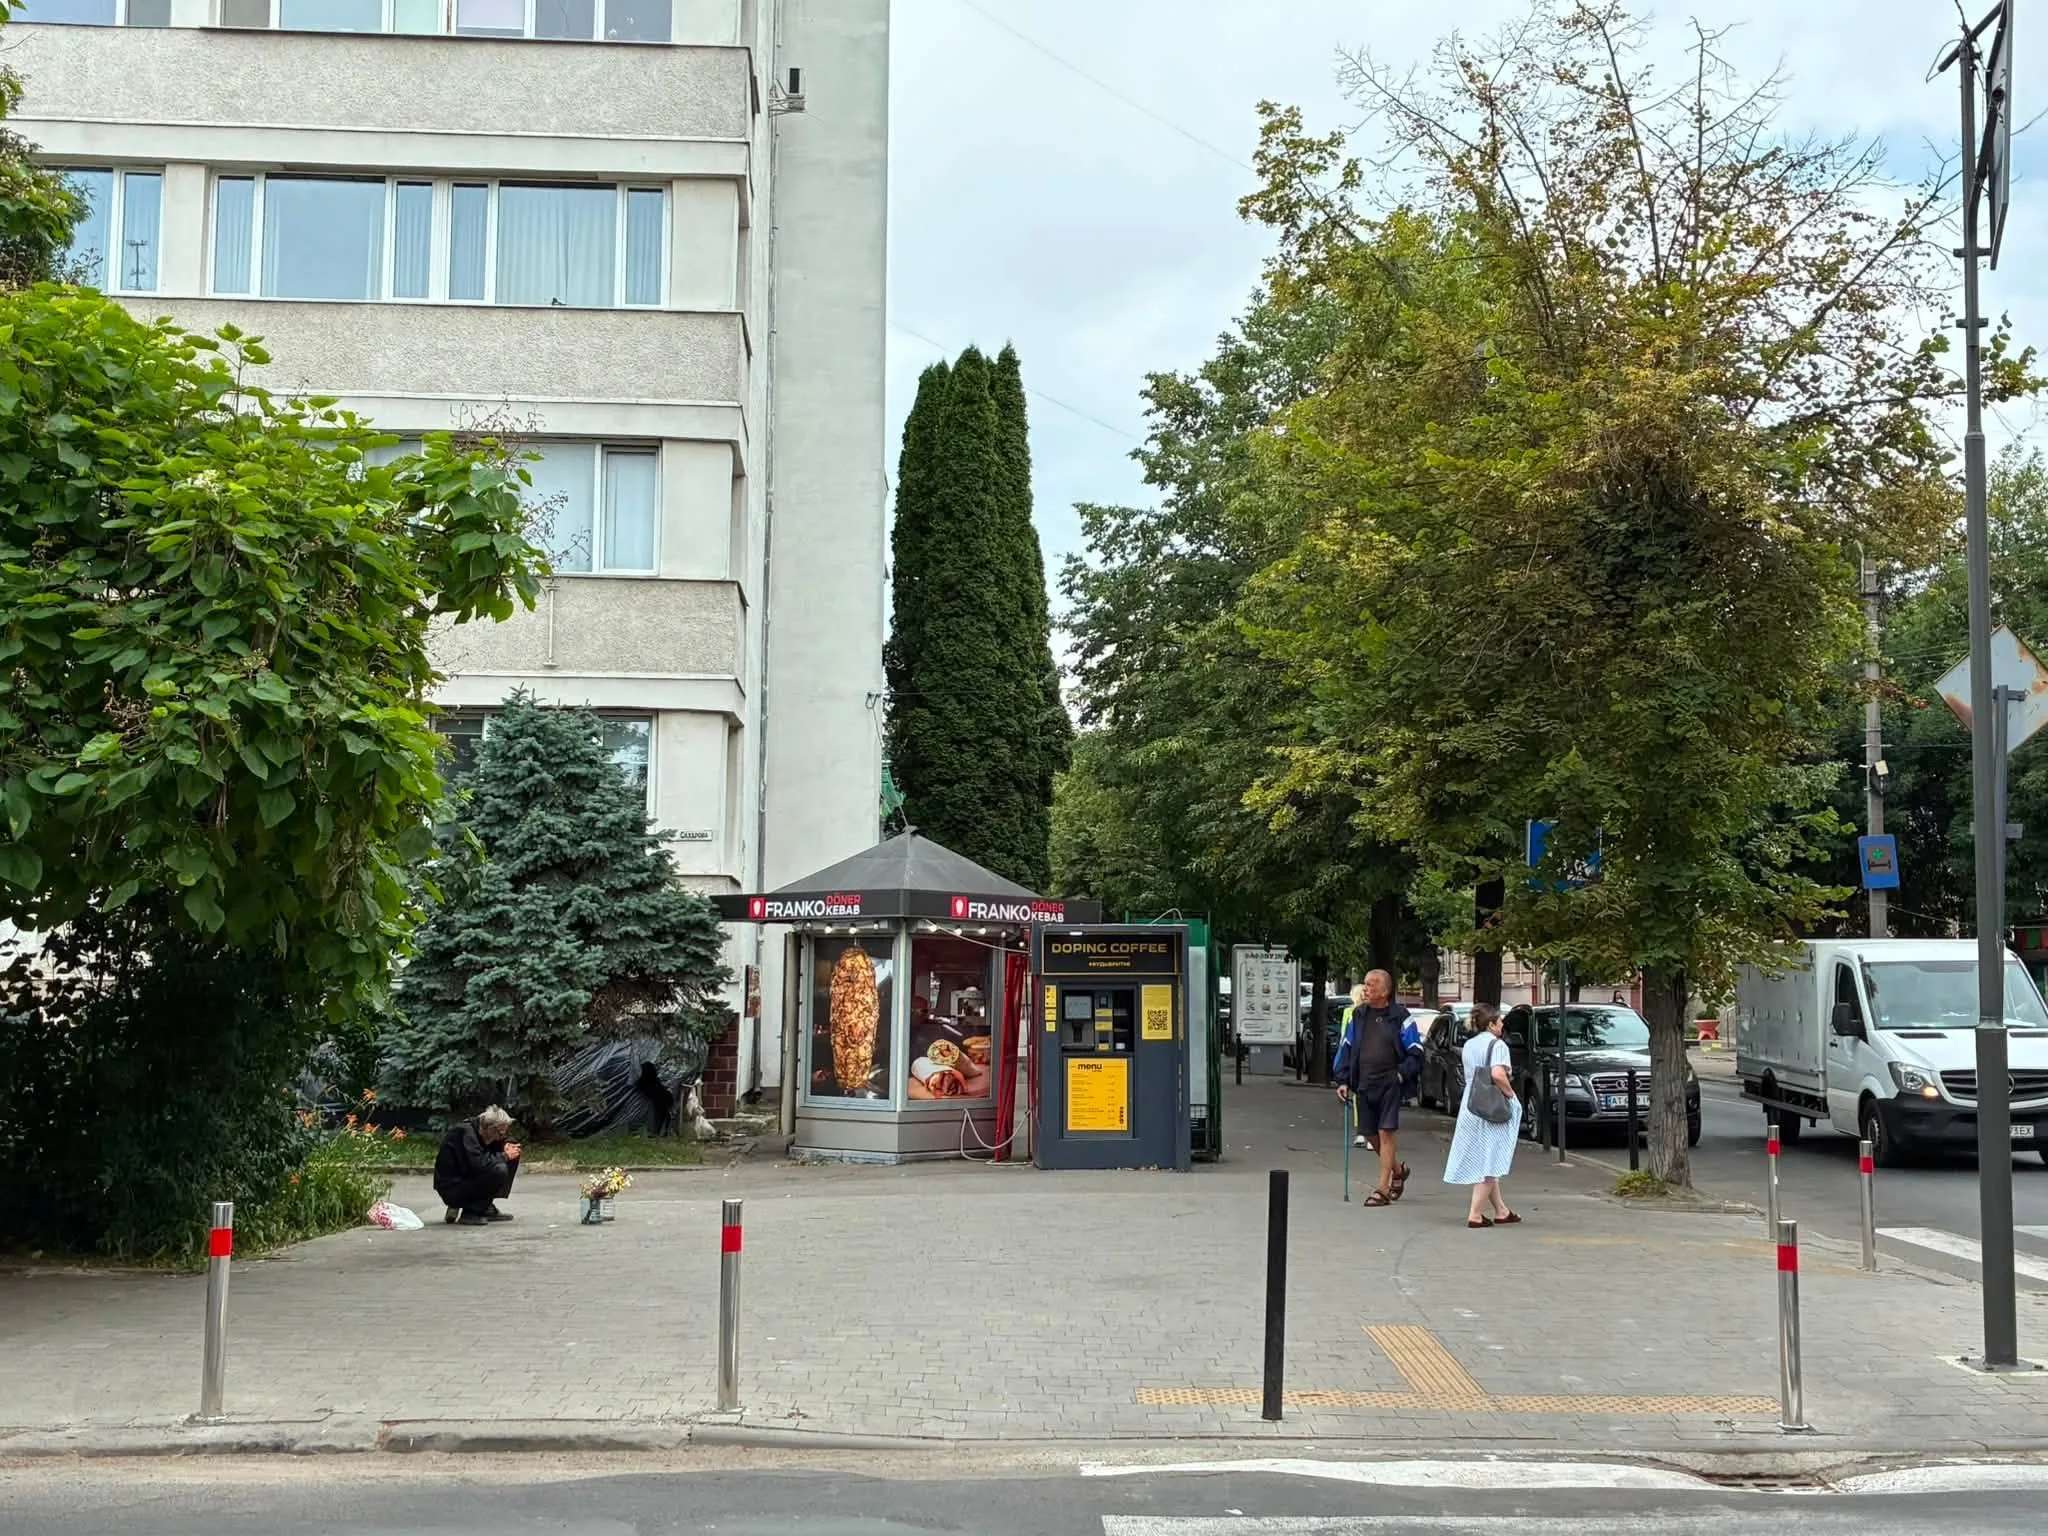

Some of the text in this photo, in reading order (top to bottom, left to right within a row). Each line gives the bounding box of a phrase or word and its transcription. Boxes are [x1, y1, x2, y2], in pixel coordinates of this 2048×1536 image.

[826, 891, 861, 905] DÖNER
[765, 899, 825, 917] FRANKO
[826, 904, 860, 916] KEBAB
[968, 901, 1031, 921] FRANKO
[1031, 900, 1064, 912] DÖNER
[1031, 911, 1064, 922] KEBAB
[1051, 943, 1167, 953] DOPING COFFEE
